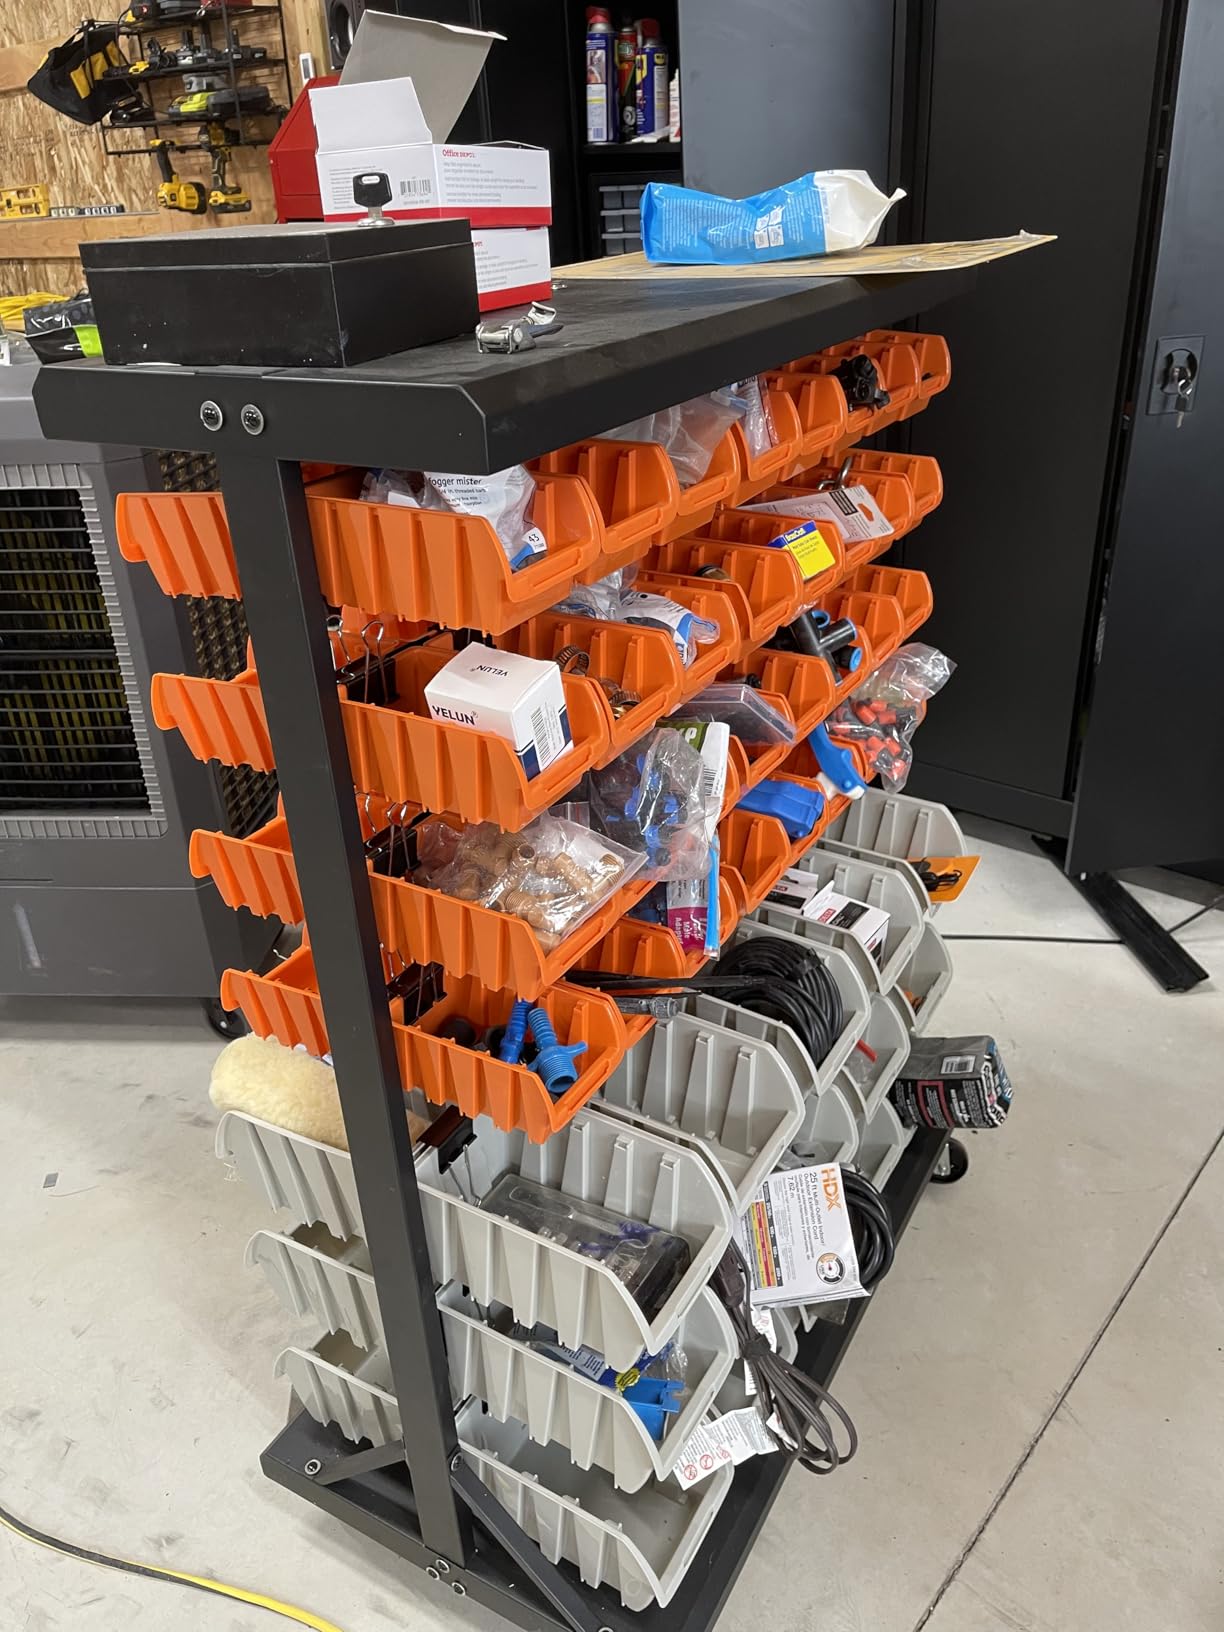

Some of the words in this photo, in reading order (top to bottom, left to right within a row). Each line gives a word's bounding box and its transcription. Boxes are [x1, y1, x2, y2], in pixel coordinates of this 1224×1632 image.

[442, 149, 459, 158] Office
[456, 476, 482, 486] mister
[528, 533, 540, 543] 43
[476, 665, 508, 677] YELUN
[432, 705, 475, 725] YELUN
[810, 1172, 817, 1183] 25
[821, 1168, 842, 1212] HDX
[808, 1197, 816, 1224] Extension
